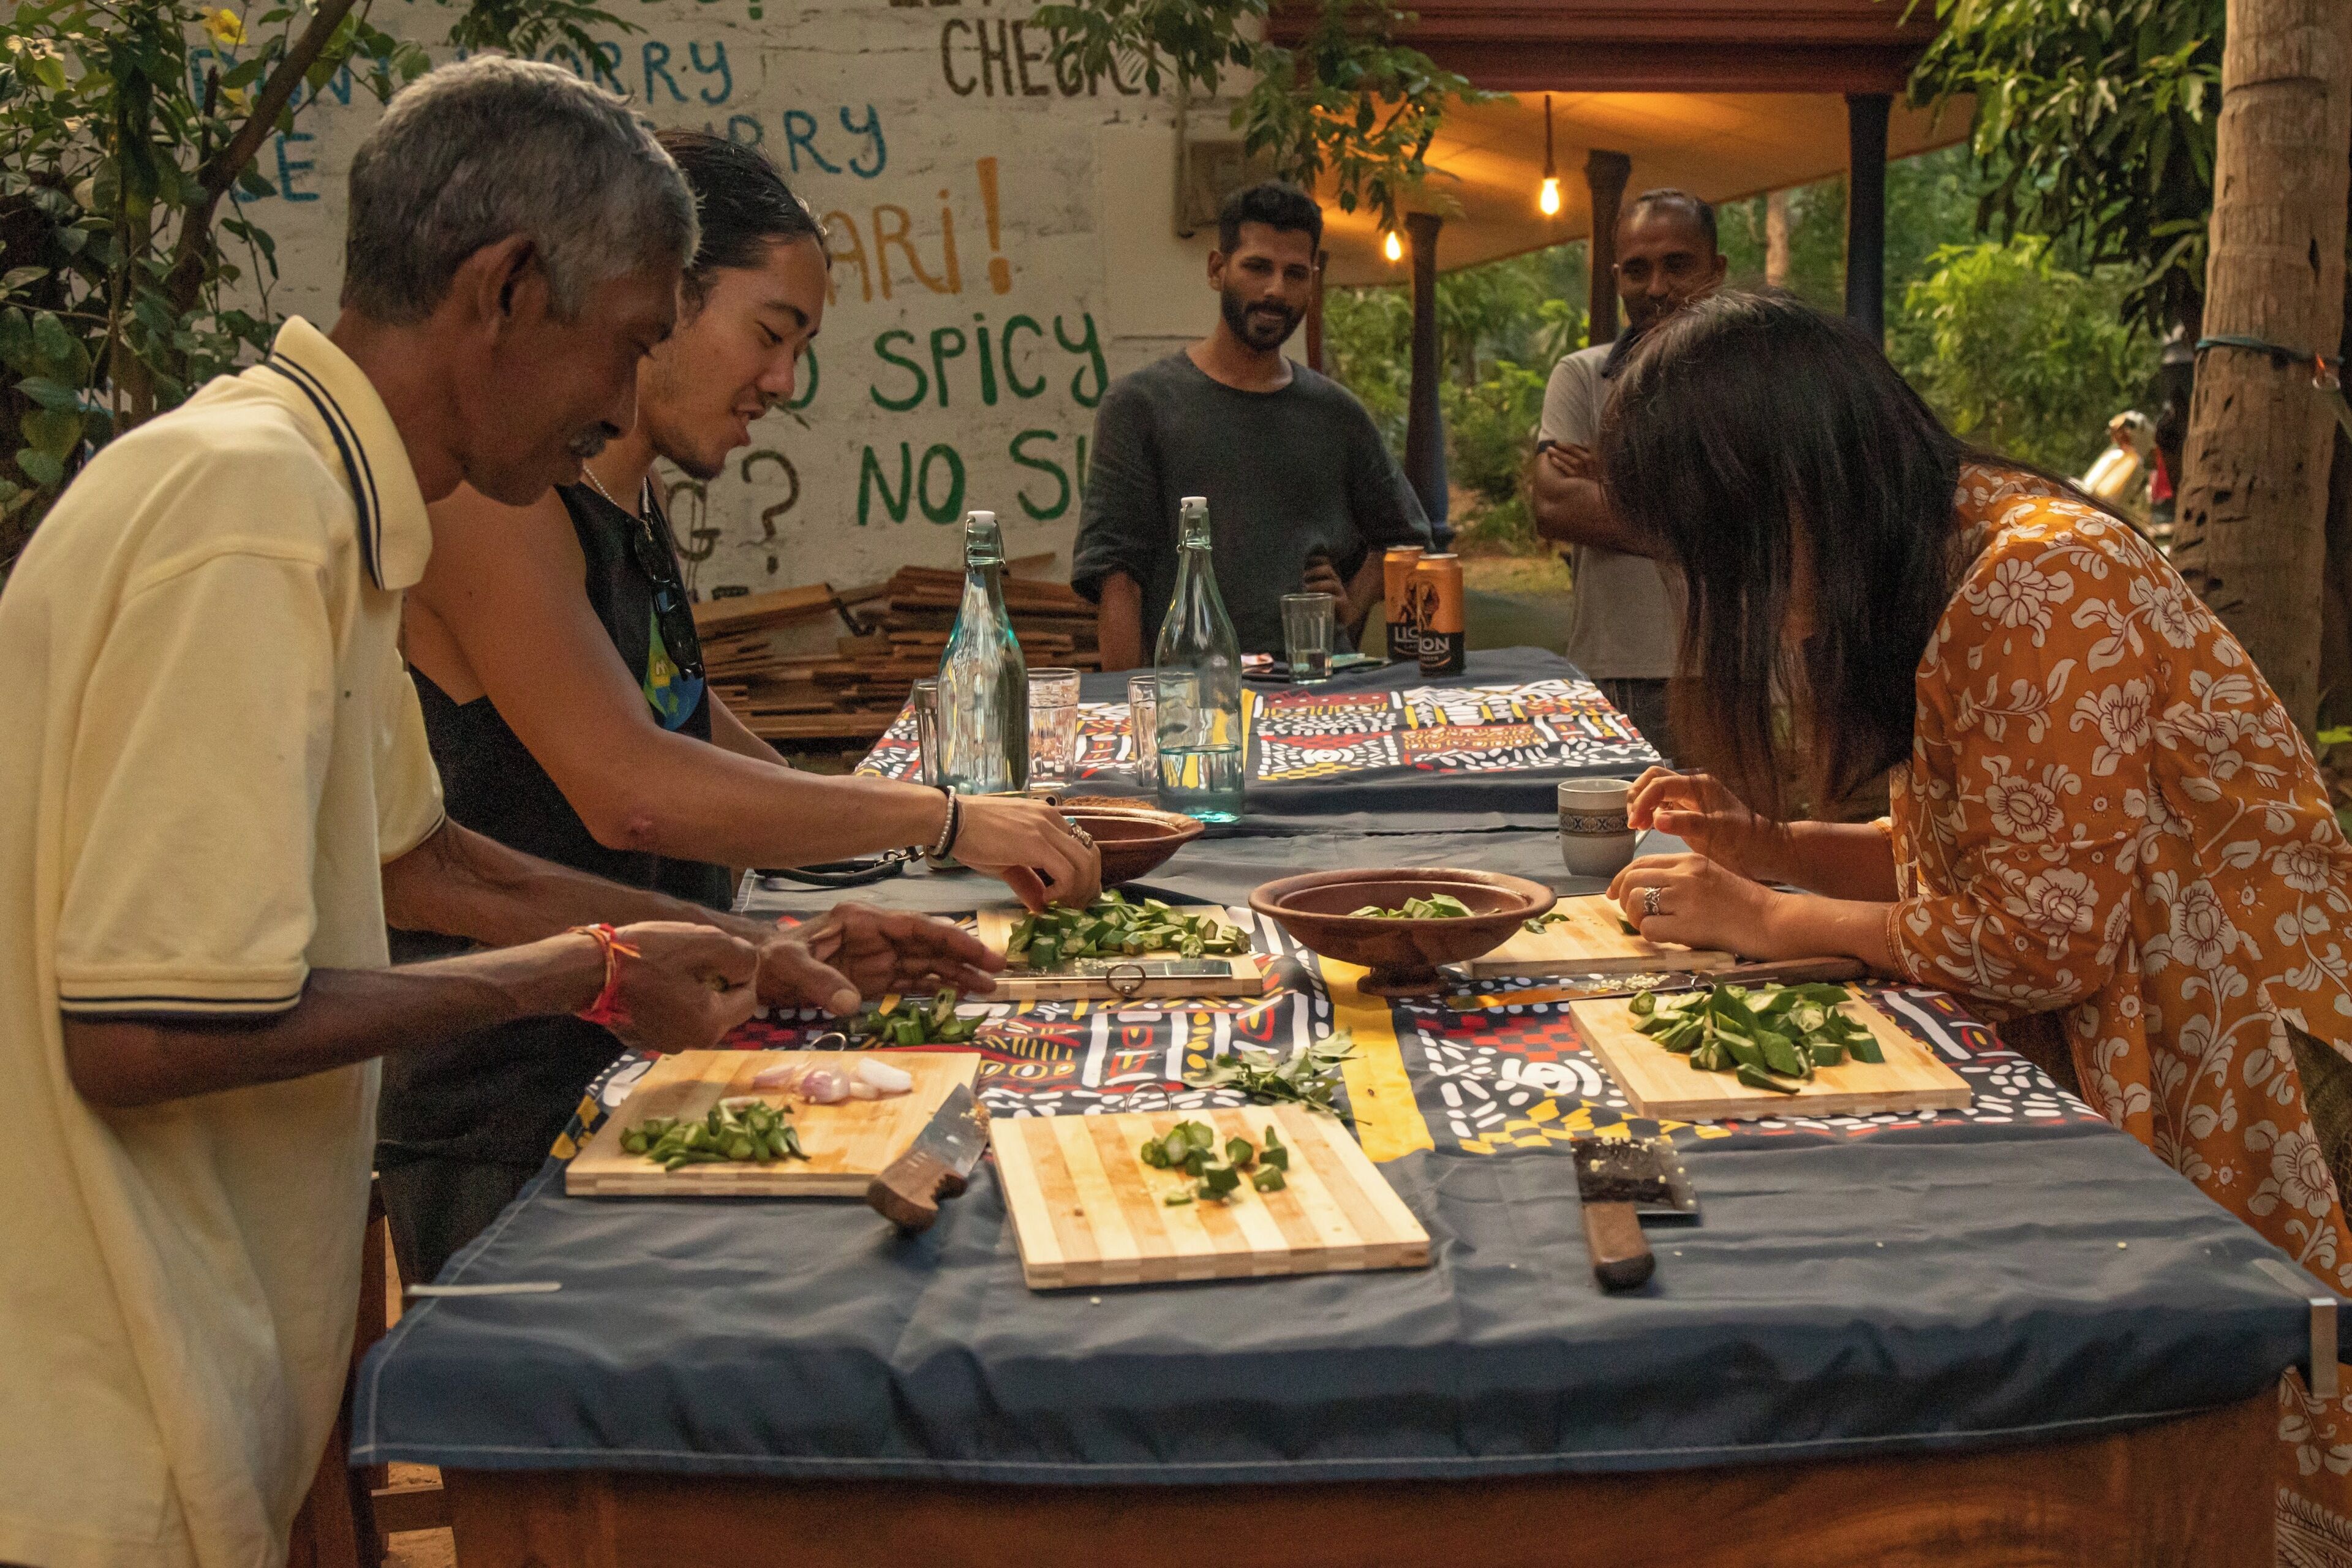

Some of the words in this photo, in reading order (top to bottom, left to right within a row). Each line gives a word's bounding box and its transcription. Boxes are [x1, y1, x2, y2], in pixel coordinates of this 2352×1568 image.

[727, 104, 886, 178] RRY
[858, 441, 966, 525] NO
[1419, 636, 1450, 655] ION
